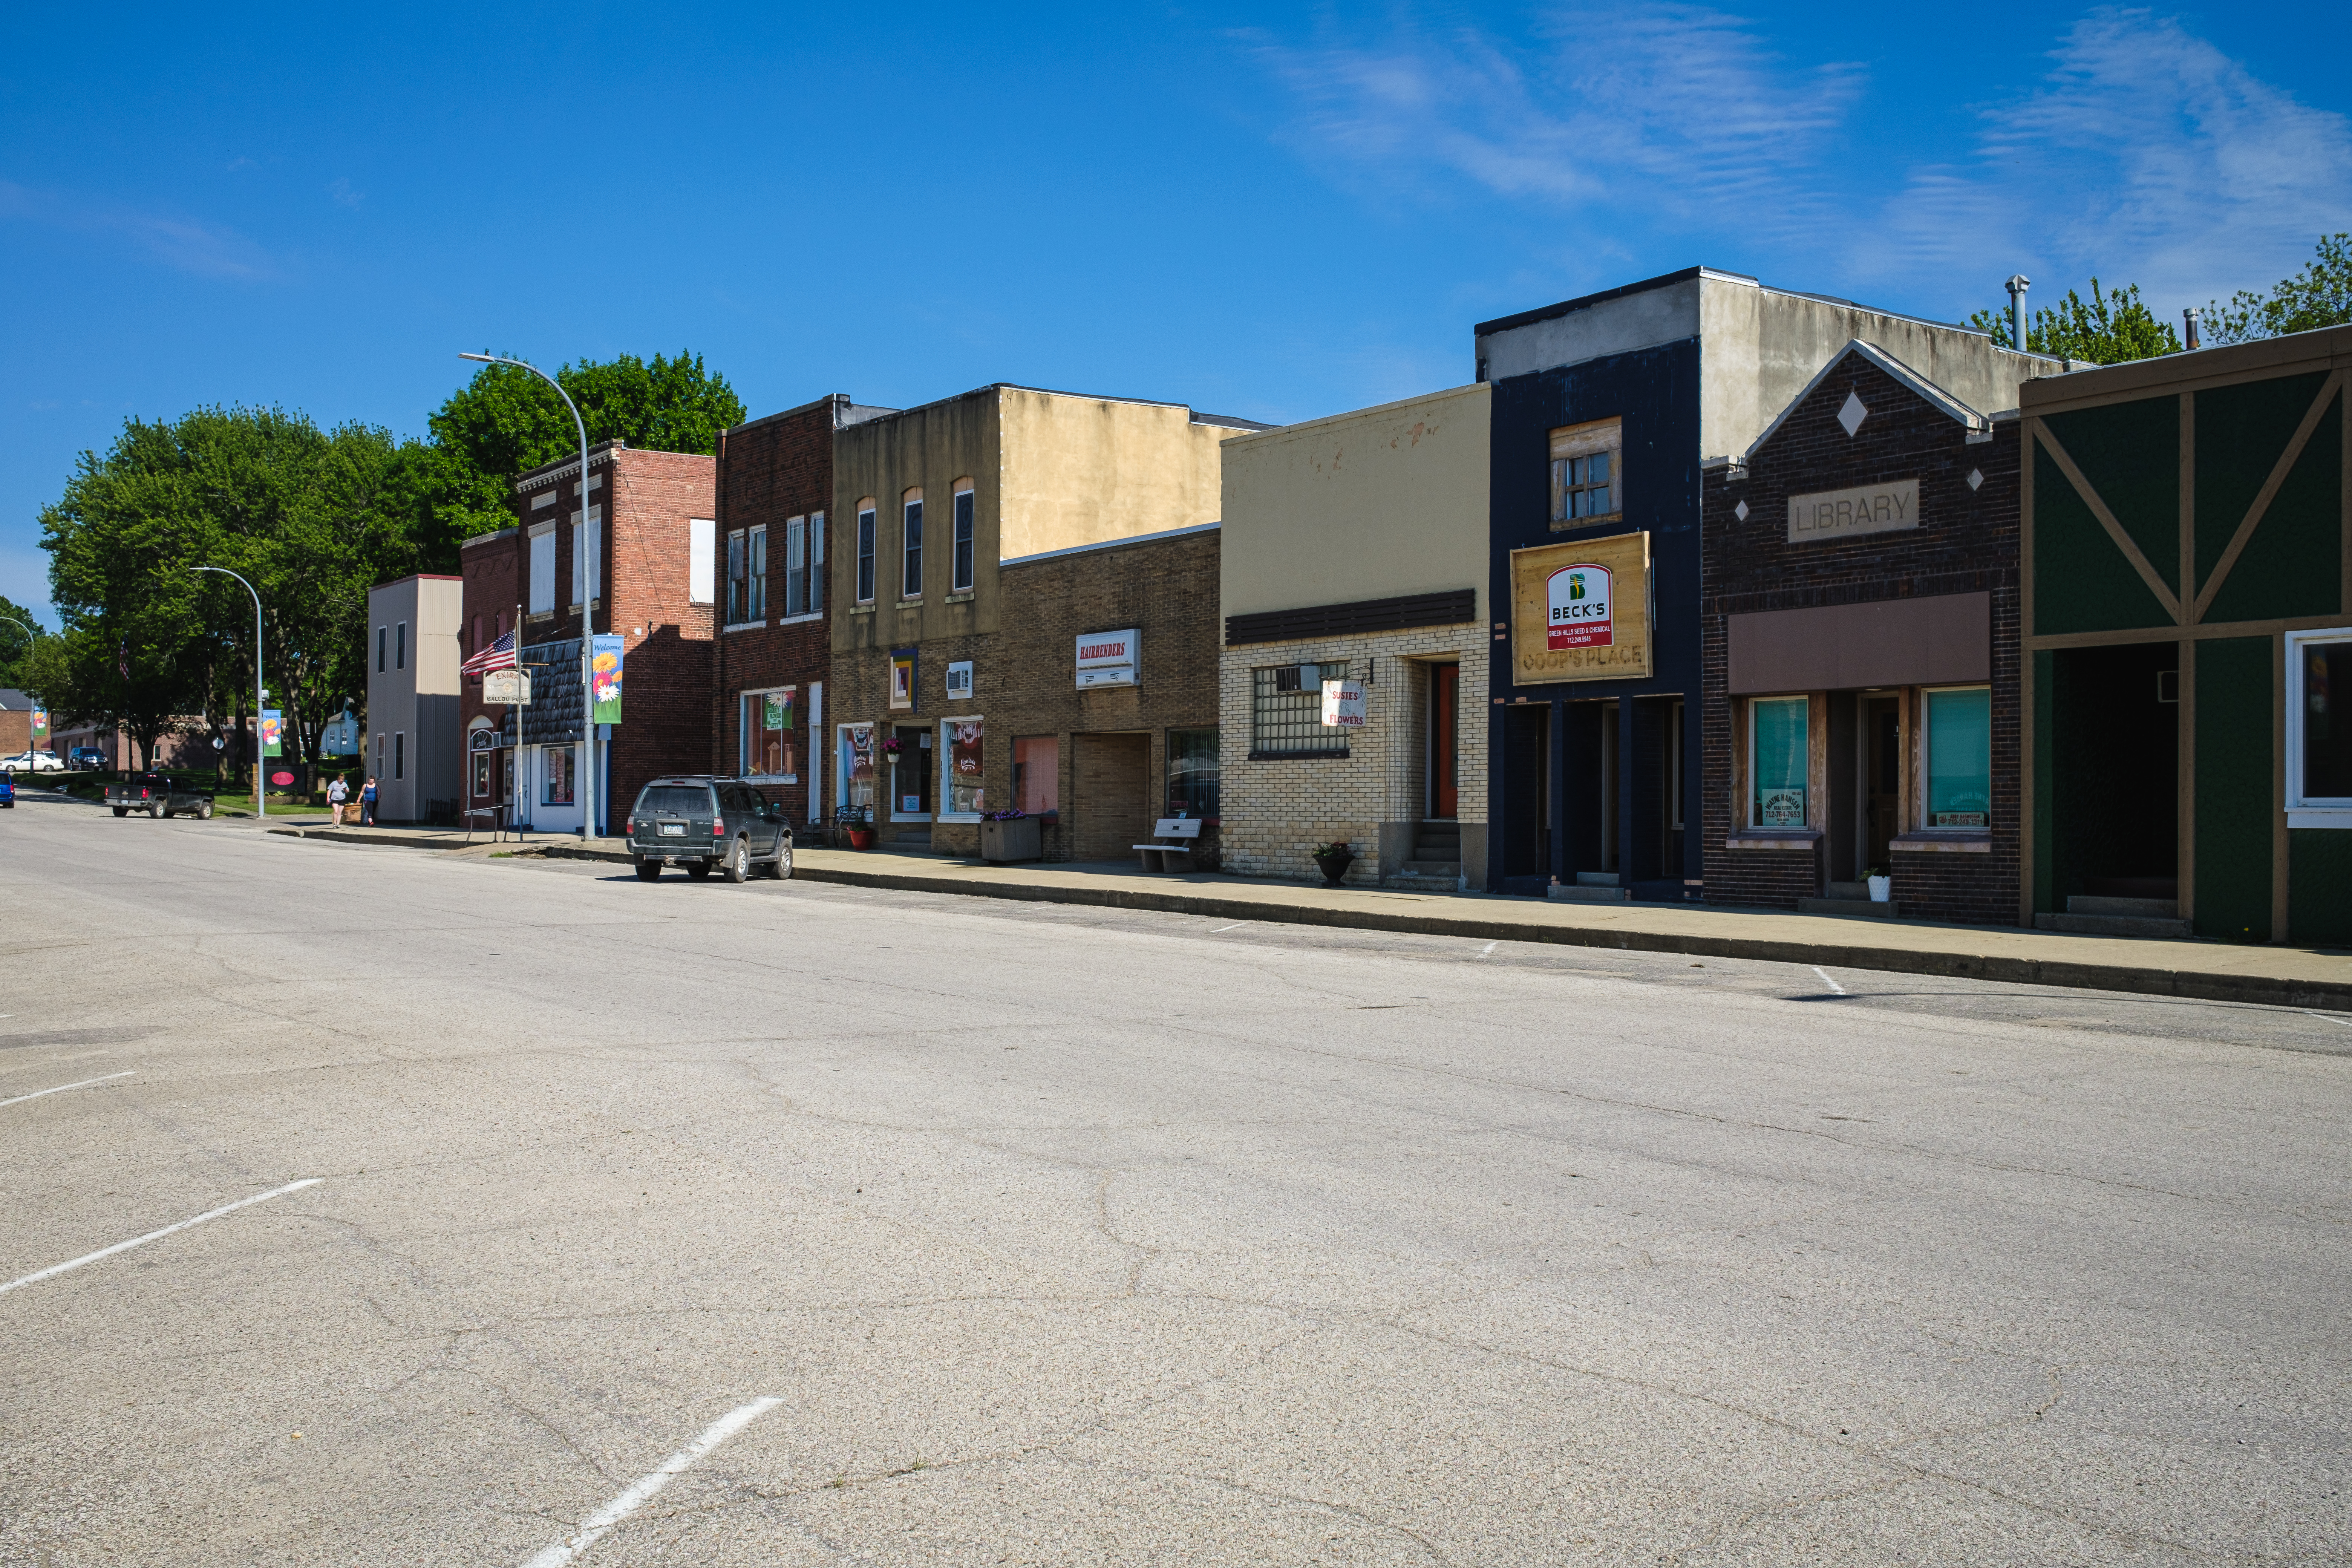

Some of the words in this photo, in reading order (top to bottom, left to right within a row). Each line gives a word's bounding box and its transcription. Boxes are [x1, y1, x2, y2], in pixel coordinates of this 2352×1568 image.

[1796, 492, 1910, 532] LIBRARY
[1570, 573, 1585, 600] B
[1553, 603, 1605, 620] BECK'S
[1080, 642, 1125, 660] HAIRBENDERS
[1586, 645, 1642, 666] PLACE
[1332, 691, 1358, 701] SUSIE'S
[1330, 714, 1363, 725] FLOWERS
[1765, 794, 1780, 810] WAYNE
[1781, 794, 1801, 810] HANSEN
